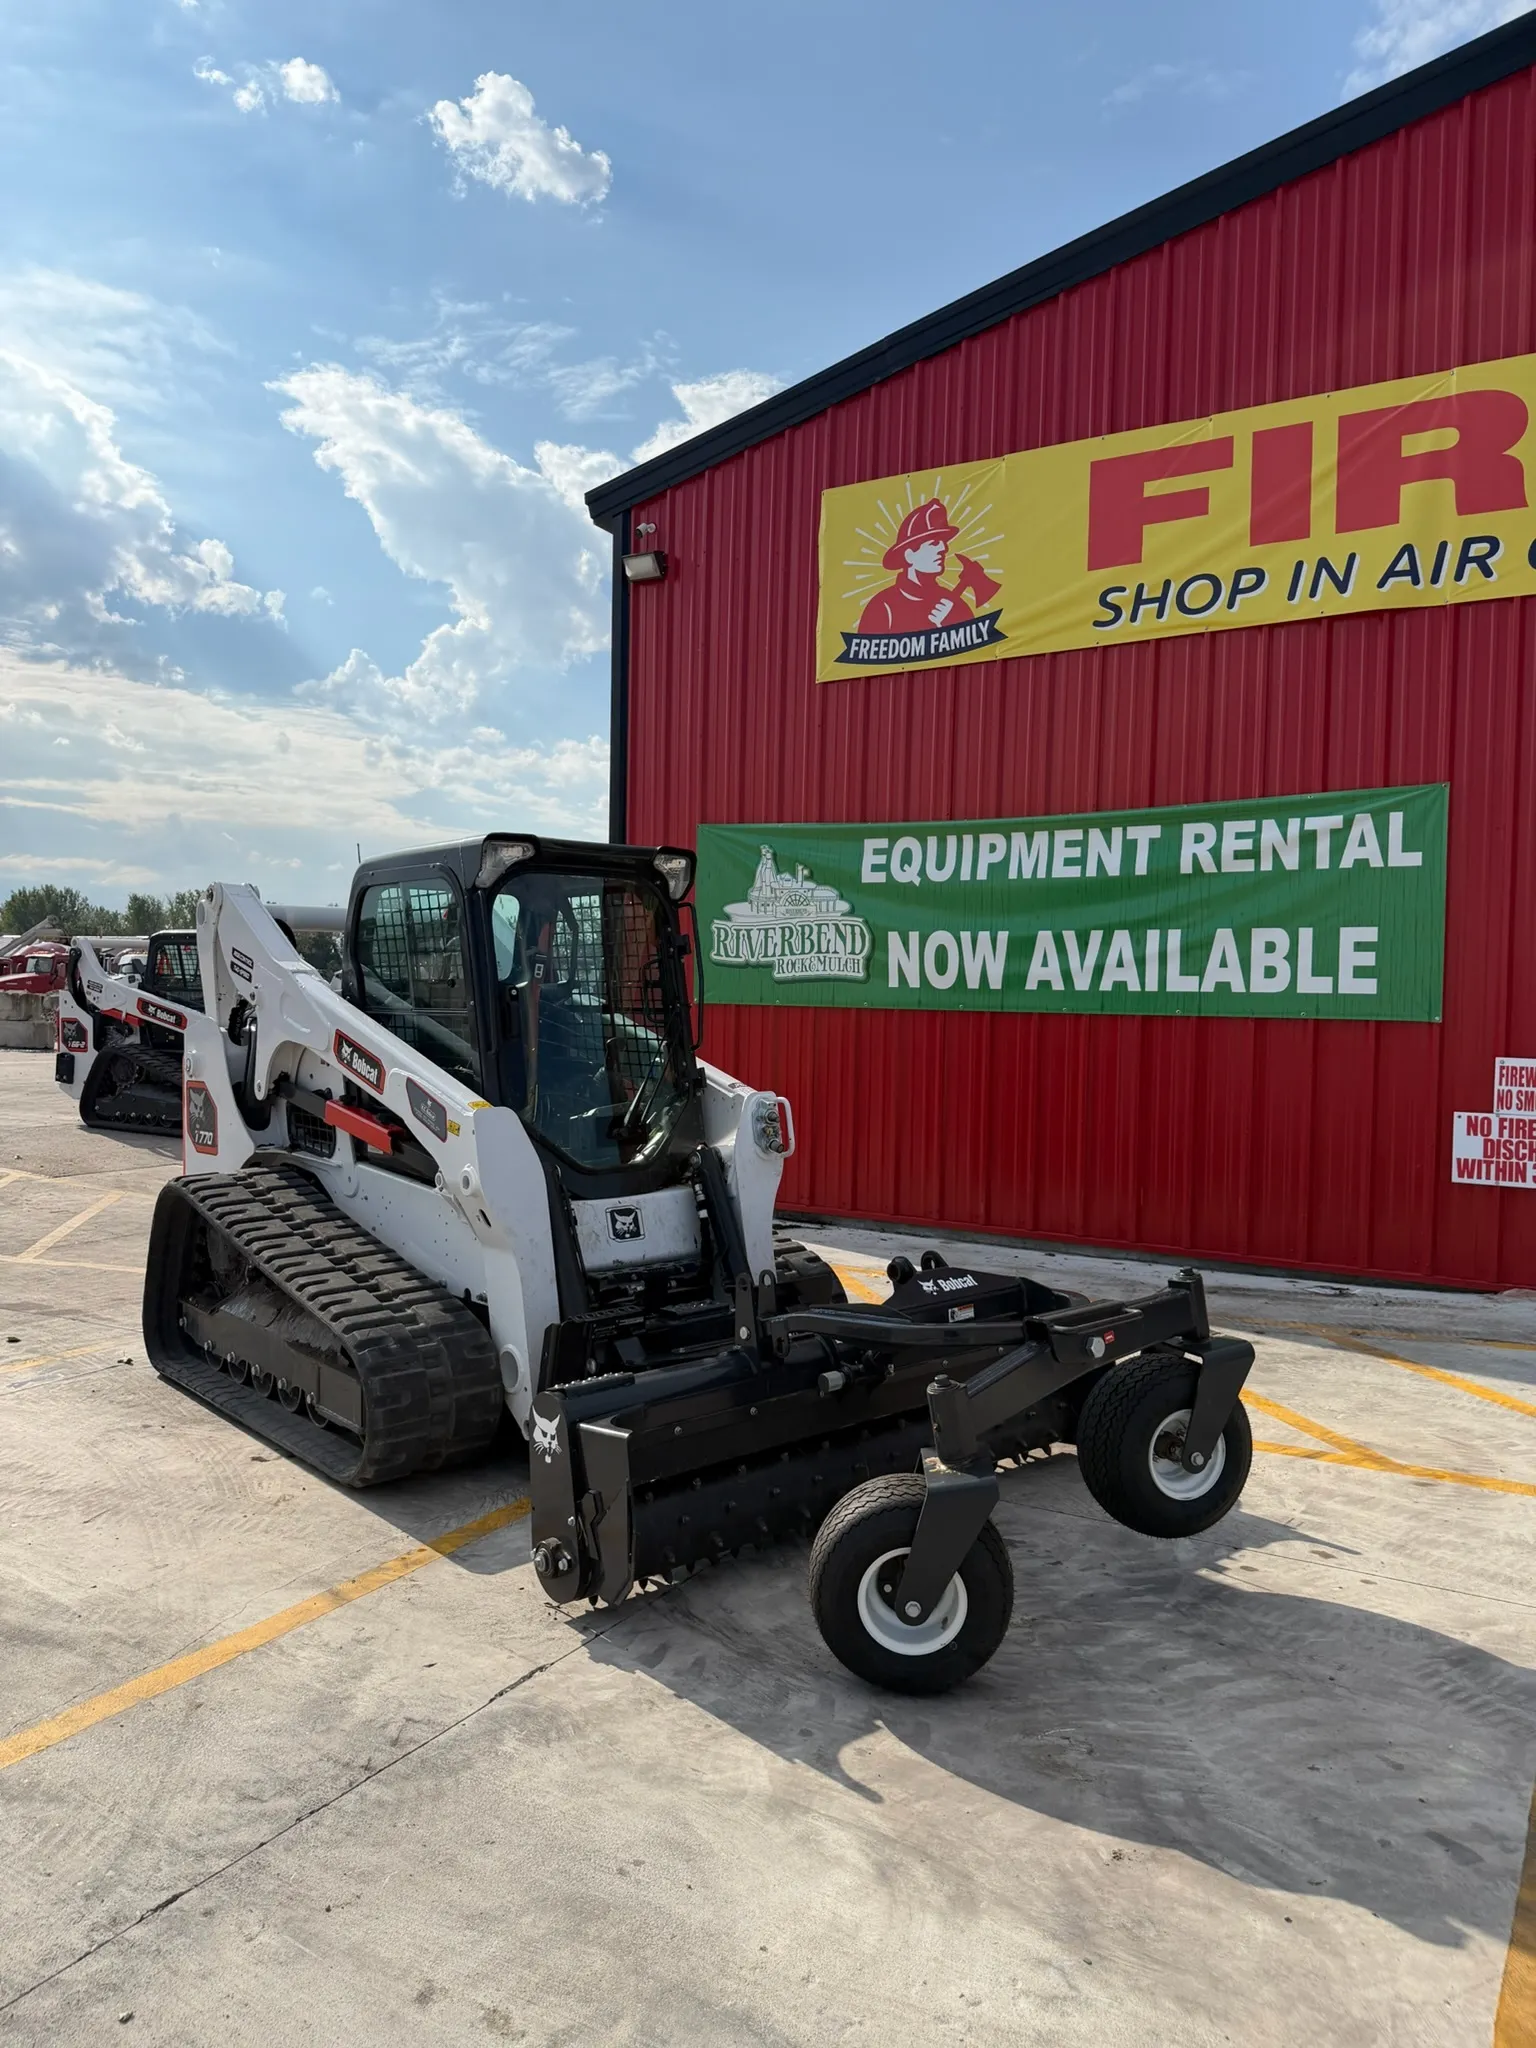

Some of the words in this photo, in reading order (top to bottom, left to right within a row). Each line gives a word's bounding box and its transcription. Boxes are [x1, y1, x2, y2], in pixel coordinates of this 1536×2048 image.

[1088, 389, 1529, 571] FIR
[1092, 567, 1268, 630] SHOP
[1287, 552, 1358, 606] IN
[1376, 535, 1503, 590] AIR
[849, 635, 926, 660] FREEDOM
[930, 619, 990, 654] FAMILY
[861, 825, 1161, 887] EQUIPMENT
[1180, 811, 1423, 874] RENTAL
[713, 922, 866, 959] RIVERBEND
[888, 930, 1009, 990] NOW
[1026, 926, 1379, 995] AVAILABLE
[156, 1009, 176, 1024] Bobcat
[352, 1052, 378, 1085] Bobcat
[1496, 1089, 1513, 1111] NO
[1515, 1089, 1536, 1112] SM
[1466, 1115, 1492, 1137] NO
[1498, 1117, 1536, 1140] FIRE
[1456, 1157, 1527, 1183] WITHIN
[937, 1274, 978, 1292] Bobcat
